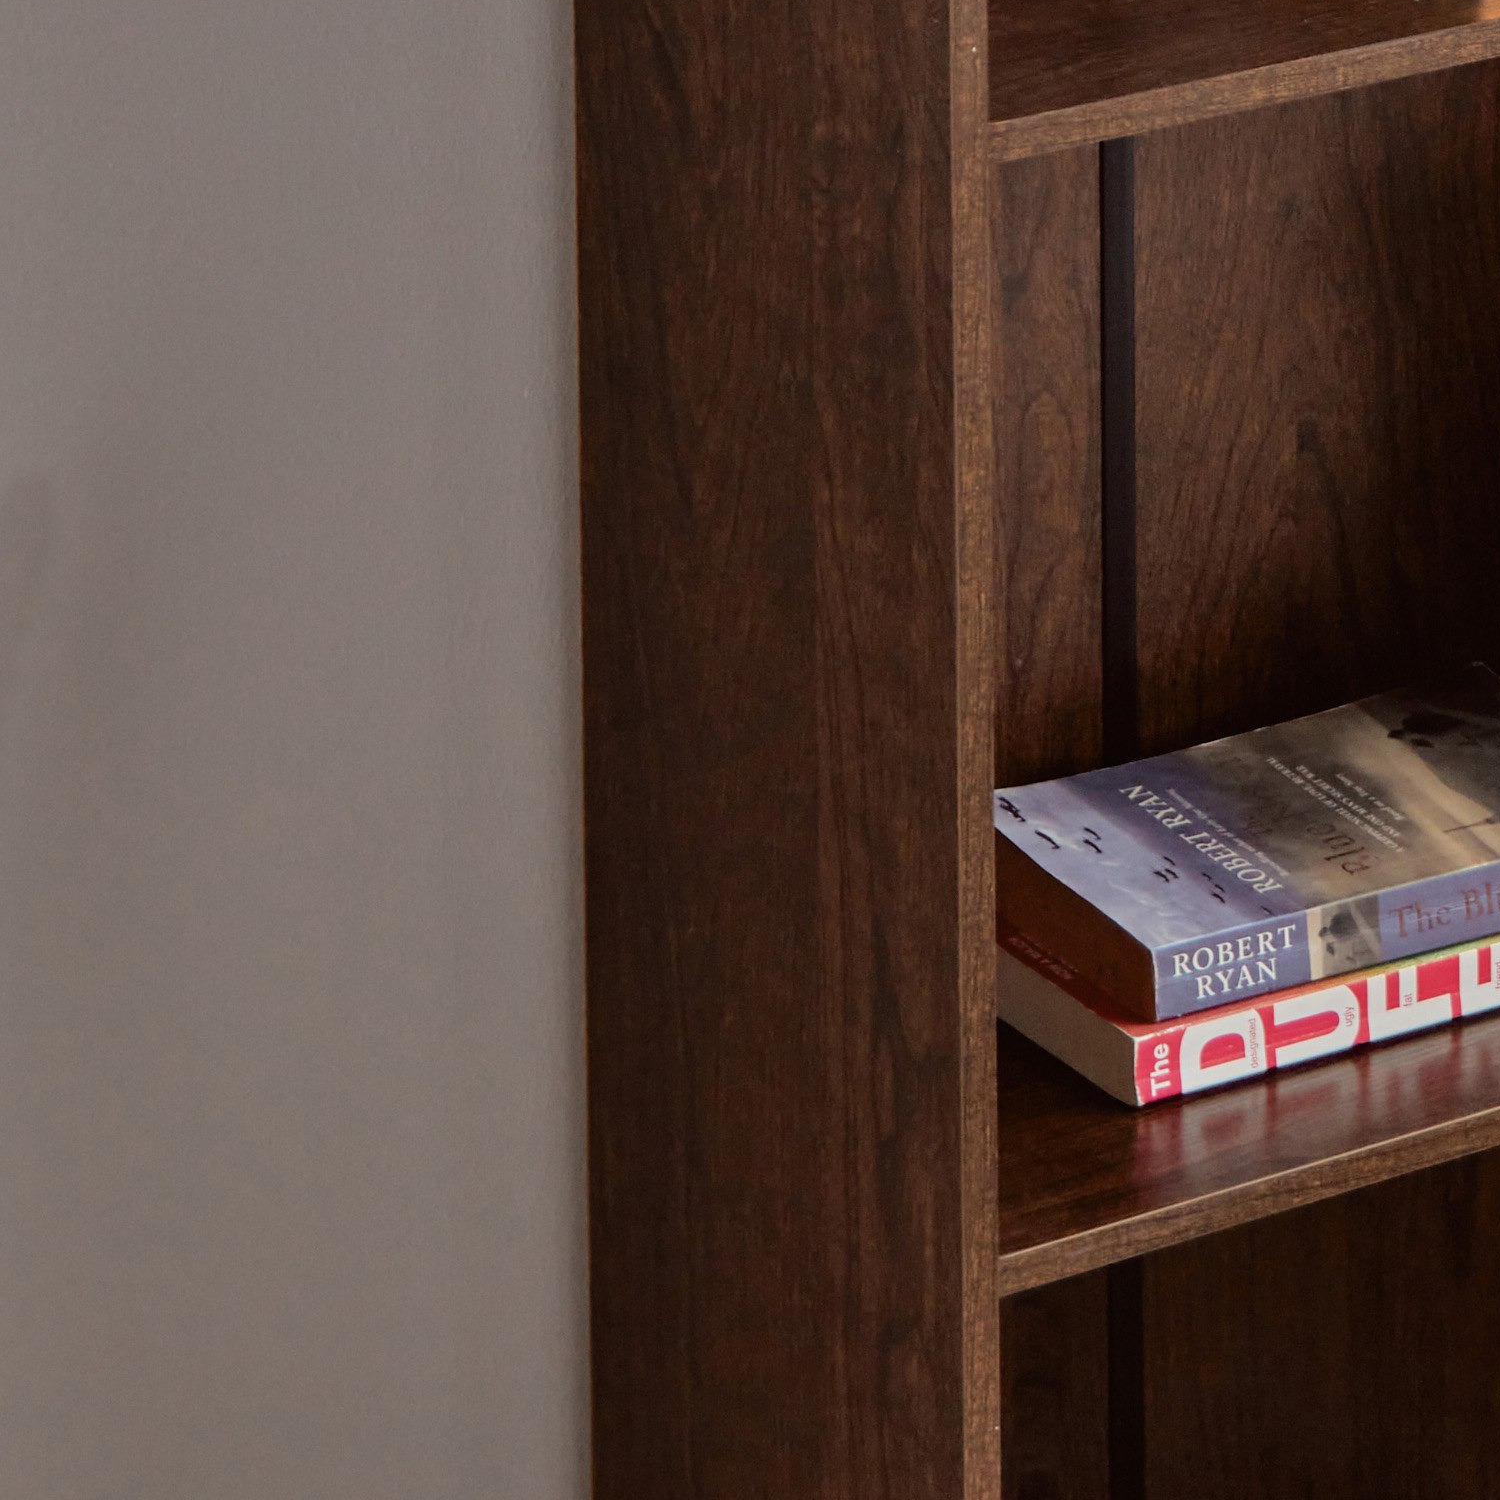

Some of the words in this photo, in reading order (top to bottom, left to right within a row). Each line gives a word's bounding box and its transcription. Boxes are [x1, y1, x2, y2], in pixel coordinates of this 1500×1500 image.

[1119, 784, 1191, 830] RYAN
[1179, 832, 1283, 894] ROBERT
[1389, 902, 1450, 939] The
[1172, 924, 1297, 978] ROBERT
[1196, 957, 1278, 1001] RYAN
[1403, 992, 1413, 1008] fat
[1343, 1006, 1355, 1029] ugly
[1248, 1018, 1258, 1070] designated
[1150, 1043, 1172, 1097] The
